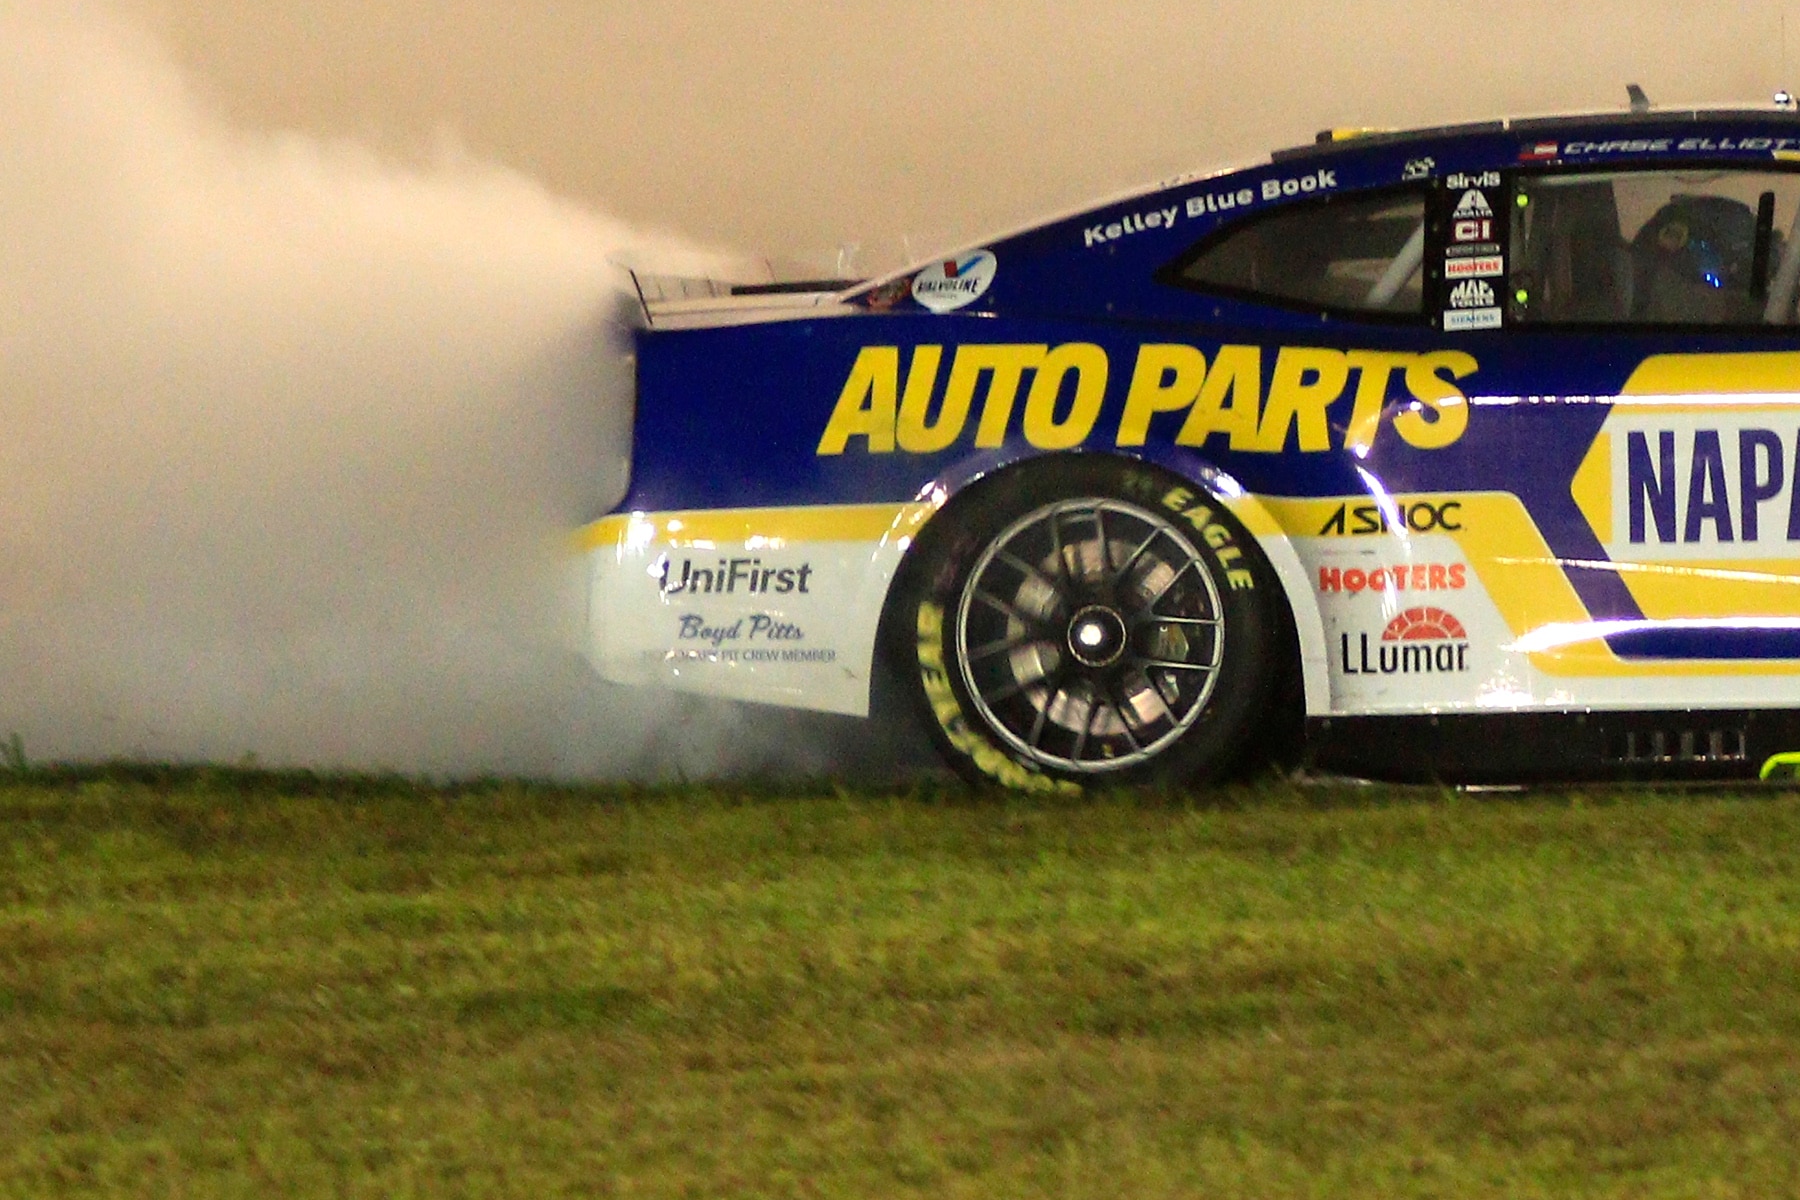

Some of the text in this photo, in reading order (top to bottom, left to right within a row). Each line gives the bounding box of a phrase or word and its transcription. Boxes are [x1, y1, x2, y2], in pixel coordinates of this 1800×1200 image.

[1084, 169, 1337, 247] Kelley Blue Book
[816, 342, 1480, 456] AUTO PARTS
[1162, 486, 1254, 592] EAGLE
[659, 559, 812, 594] UniFirst
[1319, 563, 1467, 593] HOOTERS
[678, 612, 805, 646] Boyd Pitts
[1341, 633, 1469, 675] LLumar
